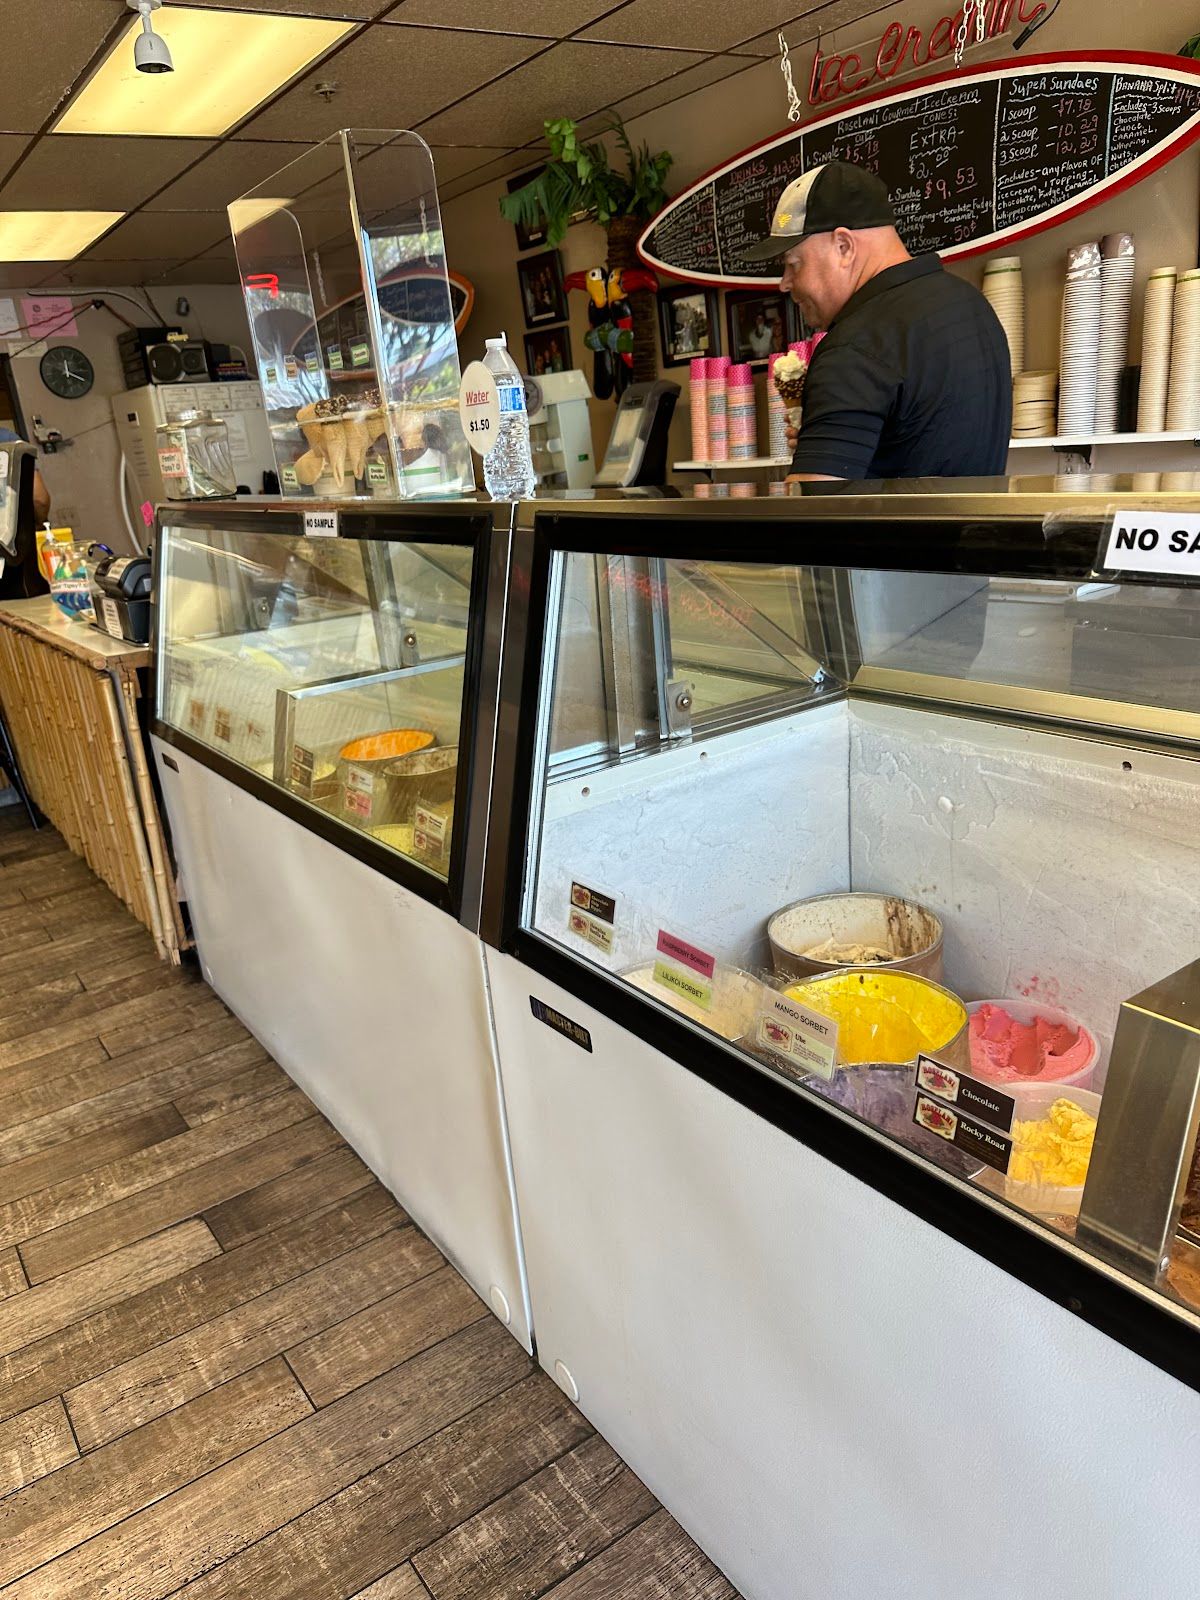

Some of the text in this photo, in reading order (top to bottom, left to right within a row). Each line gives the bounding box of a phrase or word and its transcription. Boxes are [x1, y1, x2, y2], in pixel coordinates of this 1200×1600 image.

[466, 391, 489, 405] Water
[470, 418, 490, 433] $1.50
[307, 518, 335, 528] NO SAMPLE
[1115, 528, 1160, 551] NO
[680, 981, 704, 998] SORBET
[774, 1001, 829, 1036] MANGO SORBET
[961, 1088, 1001, 1112] Chocolate
[960, 1121, 1006, 1152] Rocky Road
